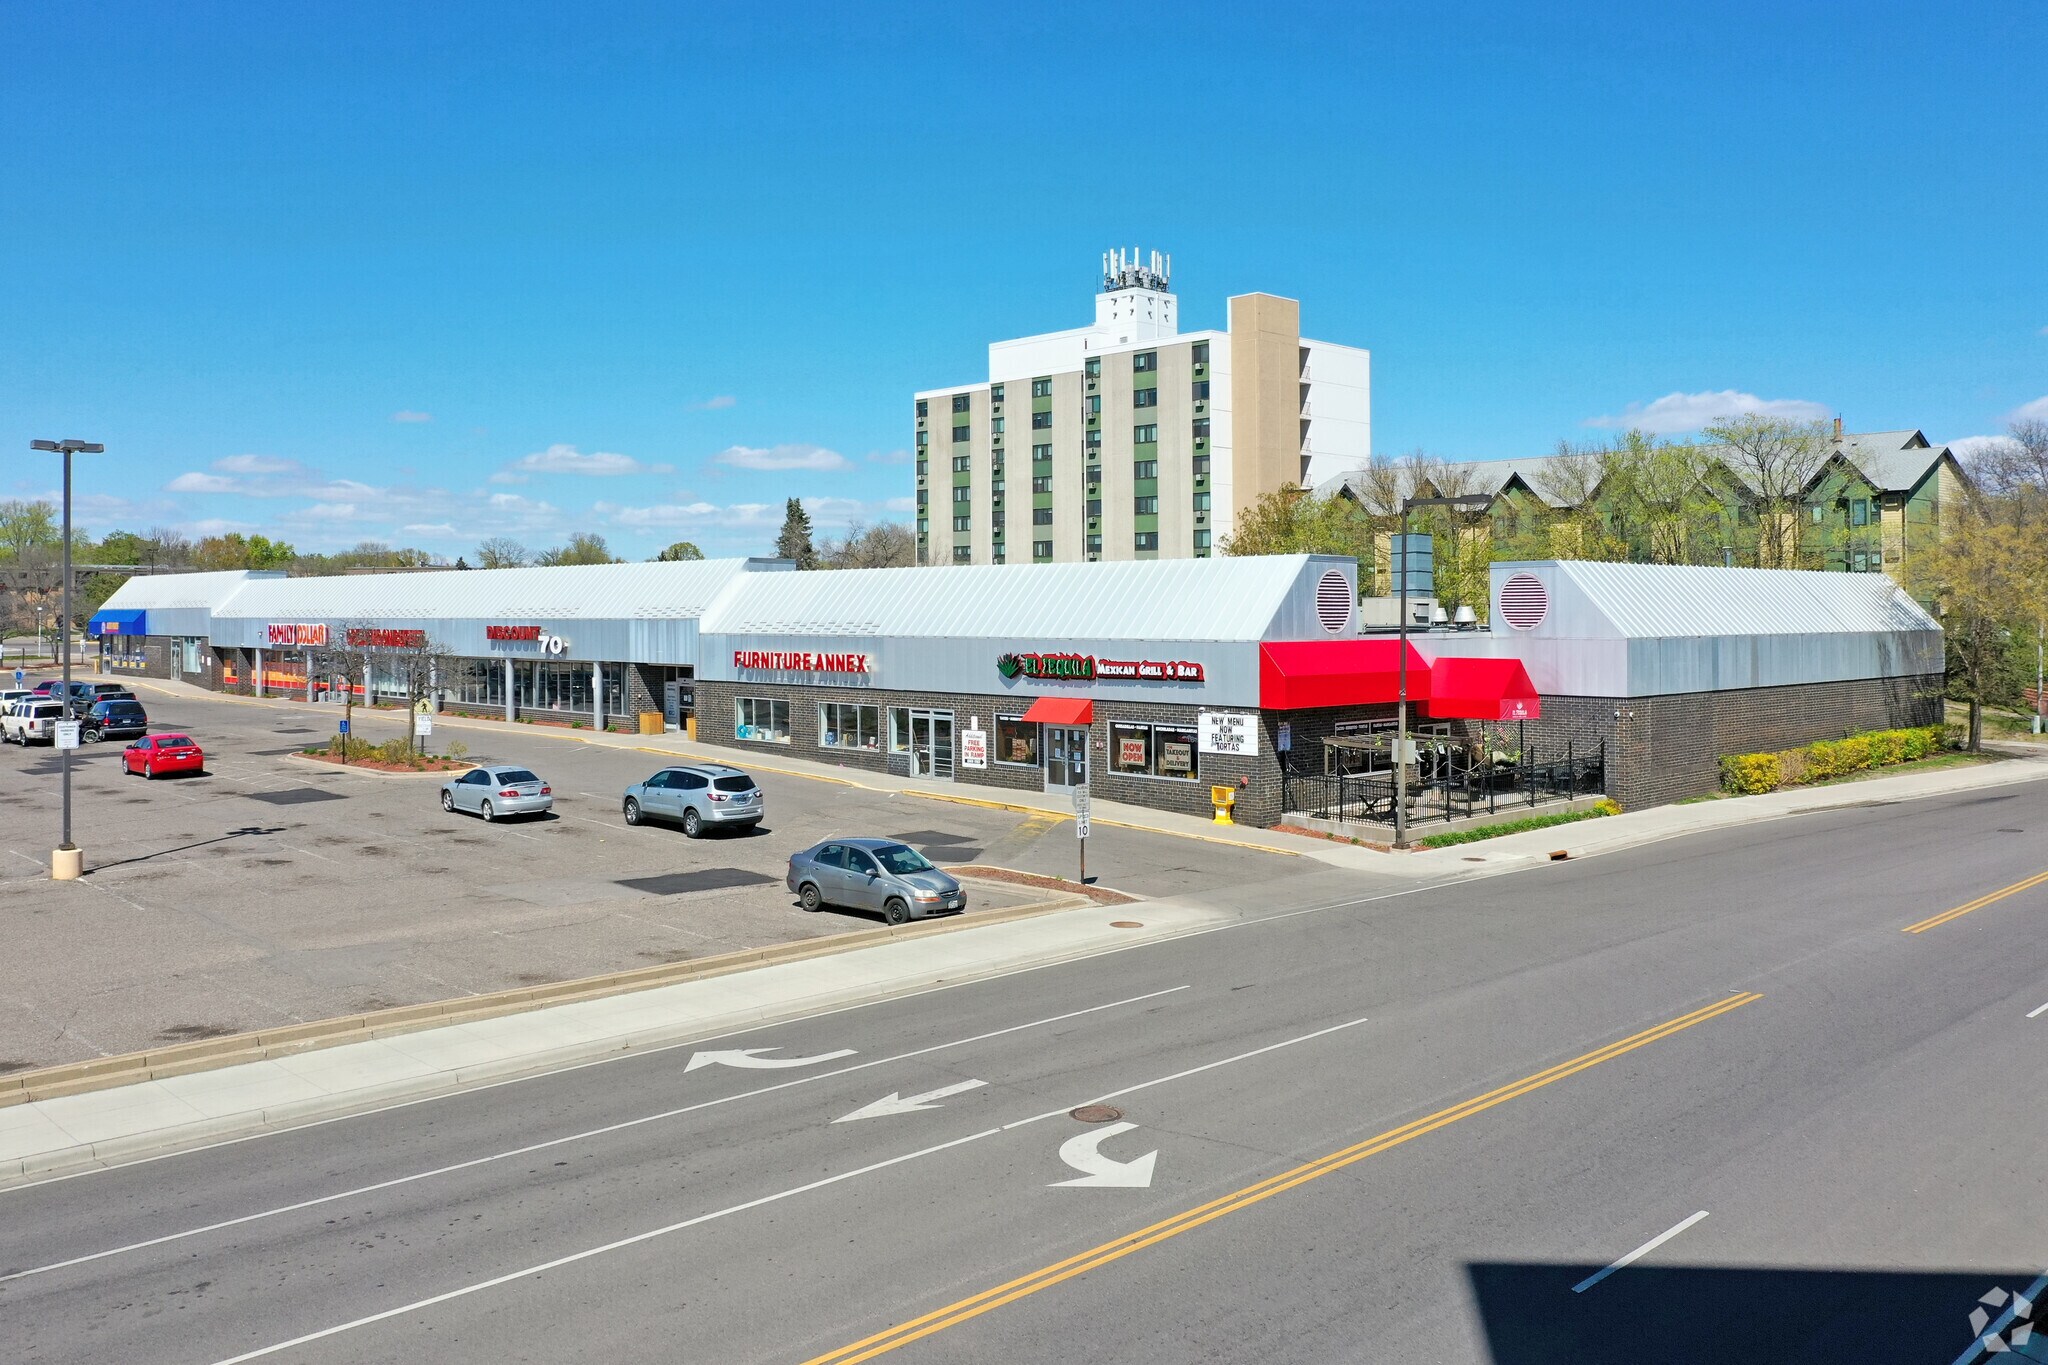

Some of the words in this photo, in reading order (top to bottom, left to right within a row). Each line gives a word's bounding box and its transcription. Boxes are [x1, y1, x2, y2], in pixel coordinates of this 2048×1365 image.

[268, 624, 294, 644] FAMILY
[297, 624, 326, 646] DOLLAR
[486, 625, 541, 641] DISCOUNT
[538, 635, 563, 655] 70
[734, 651, 812, 671] FURNITURE
[815, 653, 867, 673] ANNEX
[1025, 657, 1039, 675] EL
[1041, 657, 1092, 678] TEQUILA
[1097, 663, 1135, 675] MEXICAN
[1139, 664, 1162, 676] GRILL
[1166, 665, 1174, 676] &
[1177, 665, 1198, 677] BAR
[1211, 716, 1224, 726] NEW
[1227, 717, 1244, 726] MENU
[1219, 725, 1232, 734] NOW
[1211, 733, 1245, 743] FEATURING
[1123, 742, 1142, 752] NOW
[1216, 742, 1240, 752] TORTAS
[1122, 752, 1143, 762] OPEN
[1078, 825, 1088, 836] 10
